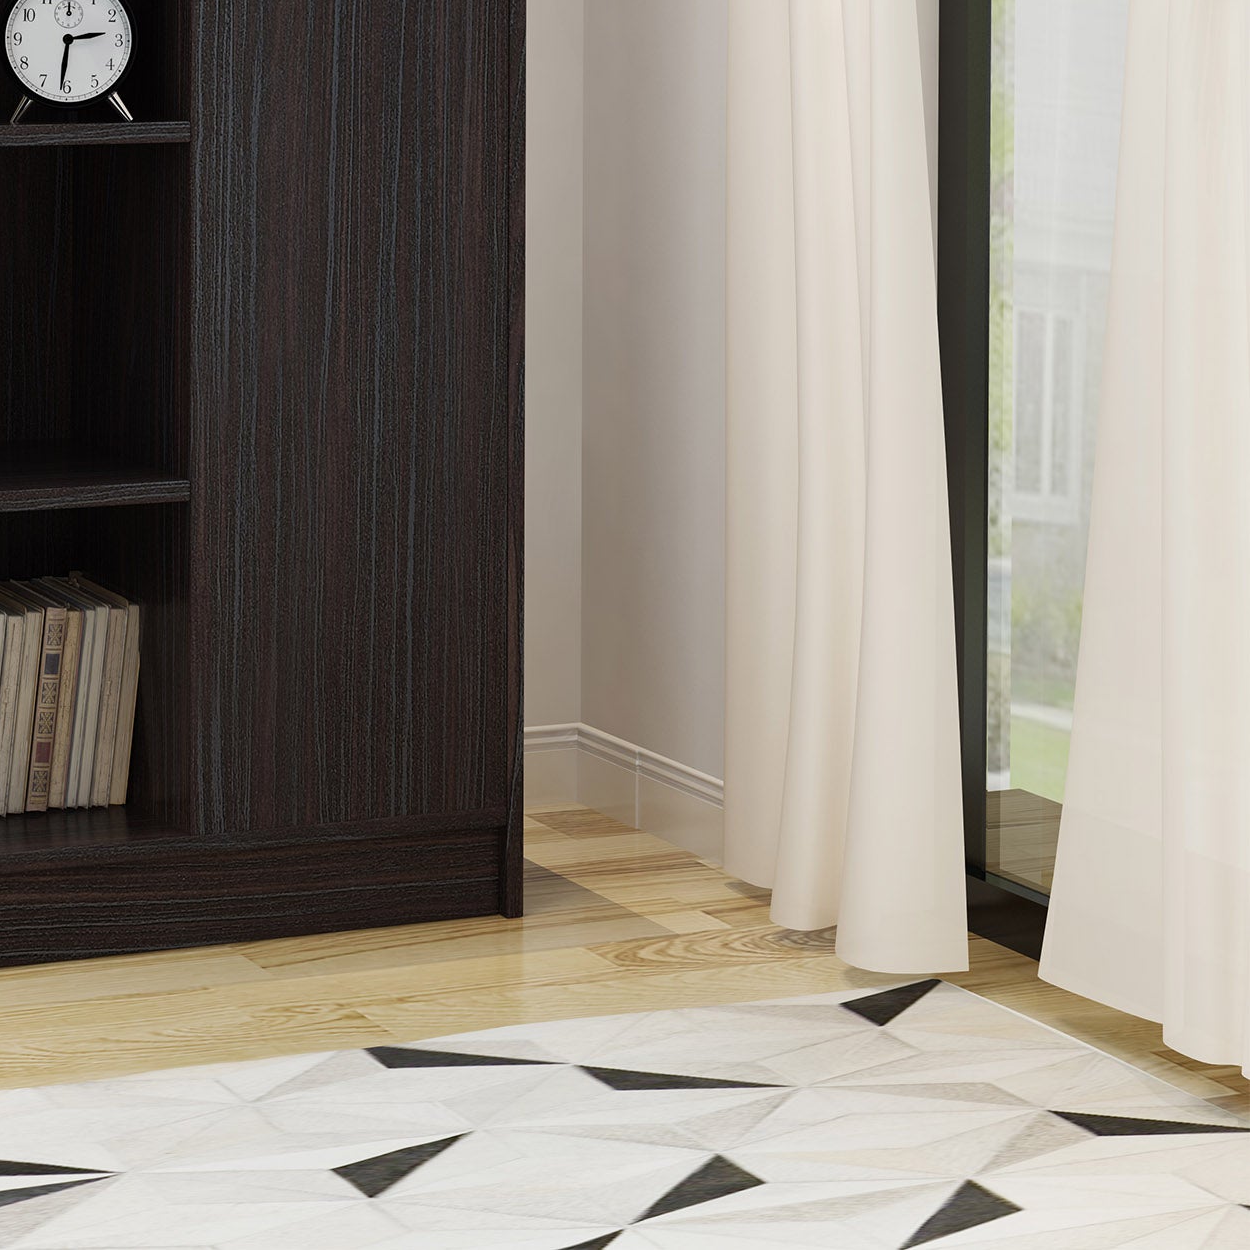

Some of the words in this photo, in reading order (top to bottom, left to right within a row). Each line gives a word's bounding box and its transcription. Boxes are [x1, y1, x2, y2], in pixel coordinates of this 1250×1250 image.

[23, 9, 35, 22] 10
[108, 9, 116, 22] 2
[14, 32, 22, 45] 9
[115, 34, 123, 47] 3
[20, 56, 28, 69] 8
[106, 58, 114, 70] 4
[39, 74, 47, 87] 7
[63, 80, 71, 94] 6
[91, 75, 98, 88] 5
